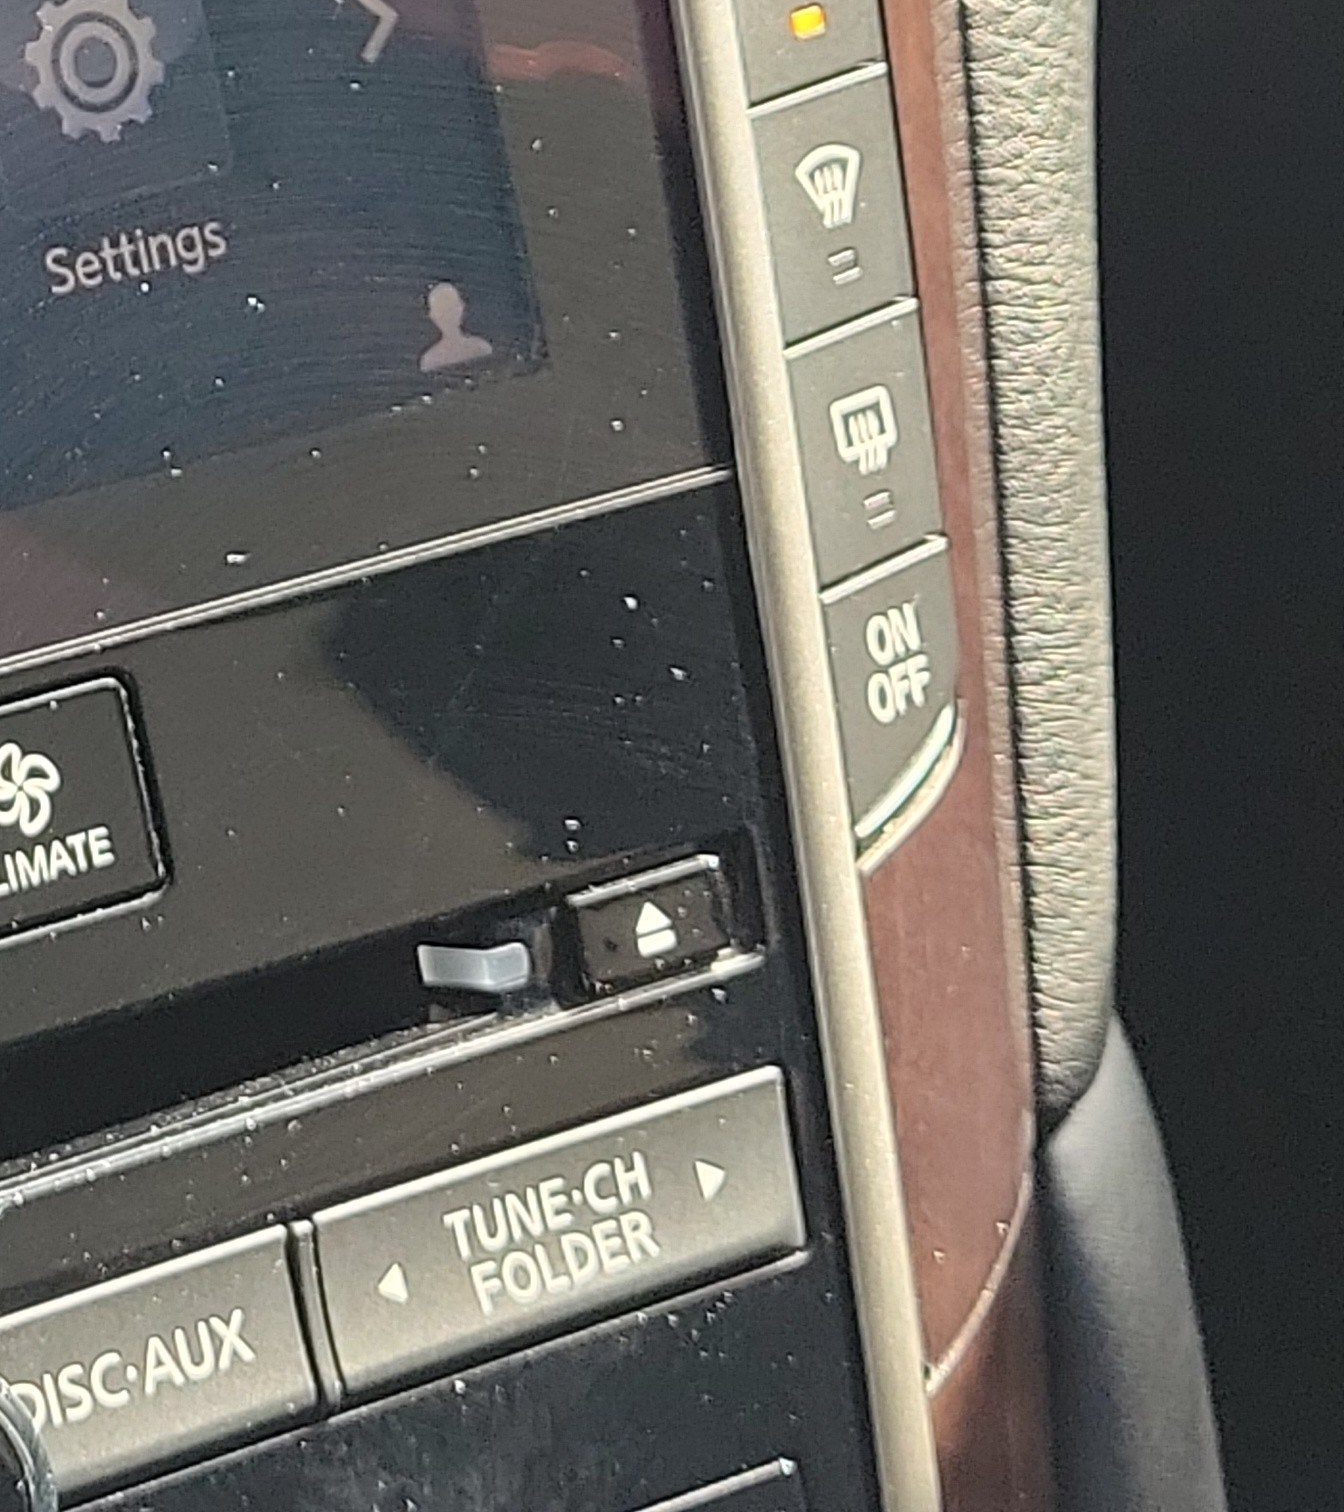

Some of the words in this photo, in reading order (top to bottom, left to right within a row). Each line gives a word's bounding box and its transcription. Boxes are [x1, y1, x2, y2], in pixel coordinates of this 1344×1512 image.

[44, 220, 229, 296] Settings
[866, 604, 923, 669] ON
[866, 663, 931, 725] OFF
[469, 1210, 661, 1316] FOLDER
